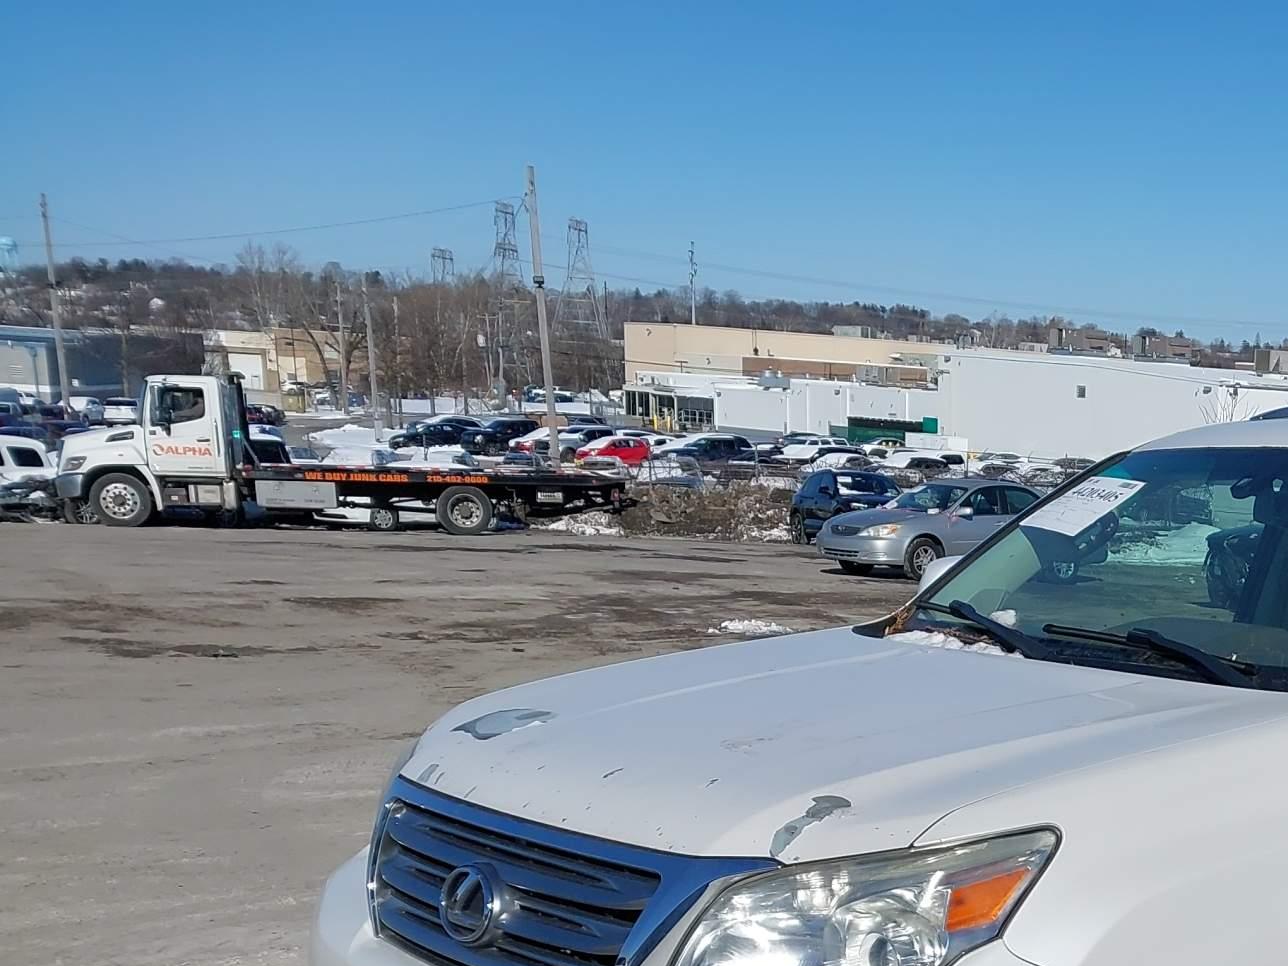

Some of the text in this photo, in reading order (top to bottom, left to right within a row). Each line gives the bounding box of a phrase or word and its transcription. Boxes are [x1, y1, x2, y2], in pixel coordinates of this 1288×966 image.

[165, 446, 212, 456] ALPHA
[304, 471, 409, 482] WE BUY JUNK CARS
[1072, 486, 1124, 503] 44203405
